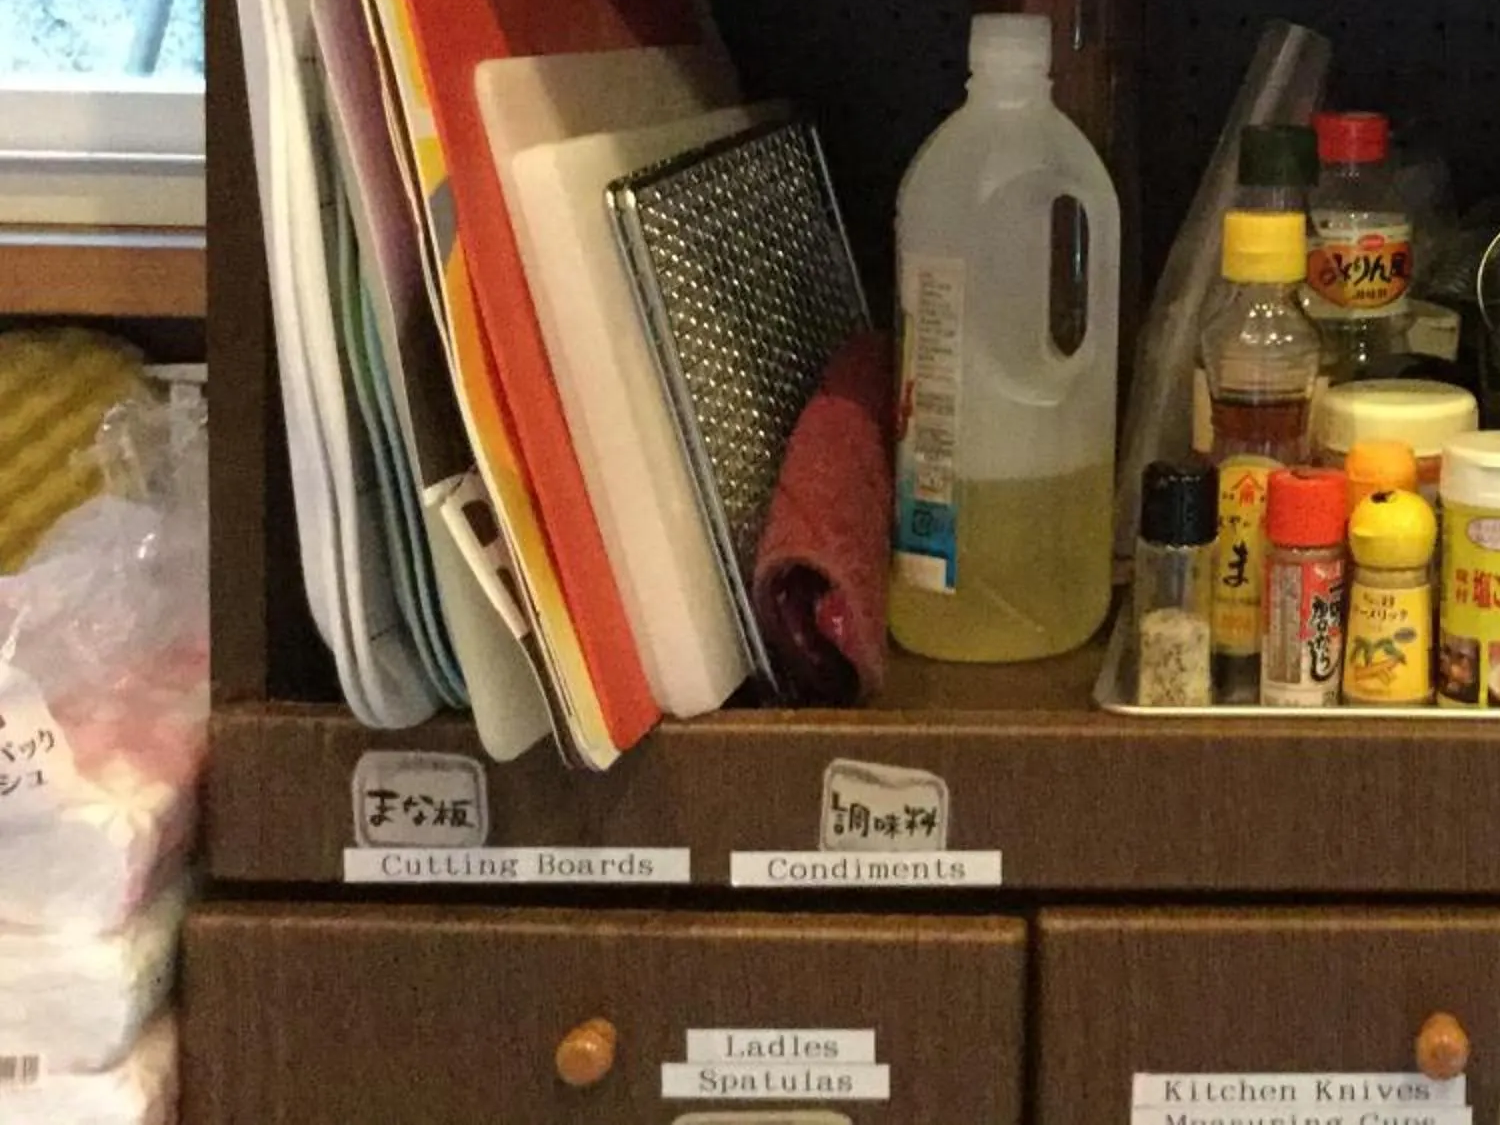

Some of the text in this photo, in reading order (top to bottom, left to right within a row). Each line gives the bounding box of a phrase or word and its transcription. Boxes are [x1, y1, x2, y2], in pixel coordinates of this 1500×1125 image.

[366, 790, 475, 827] まな板
[832, 791, 937, 839] 調味料
[381, 853, 654, 877] Cutting Boards
[767, 858, 966, 881] Condiments
[725, 1034, 839, 1059] Ladles
[699, 1069, 853, 1094] Spatulas
[1164, 1079, 1430, 1103] Kitchen Knives
